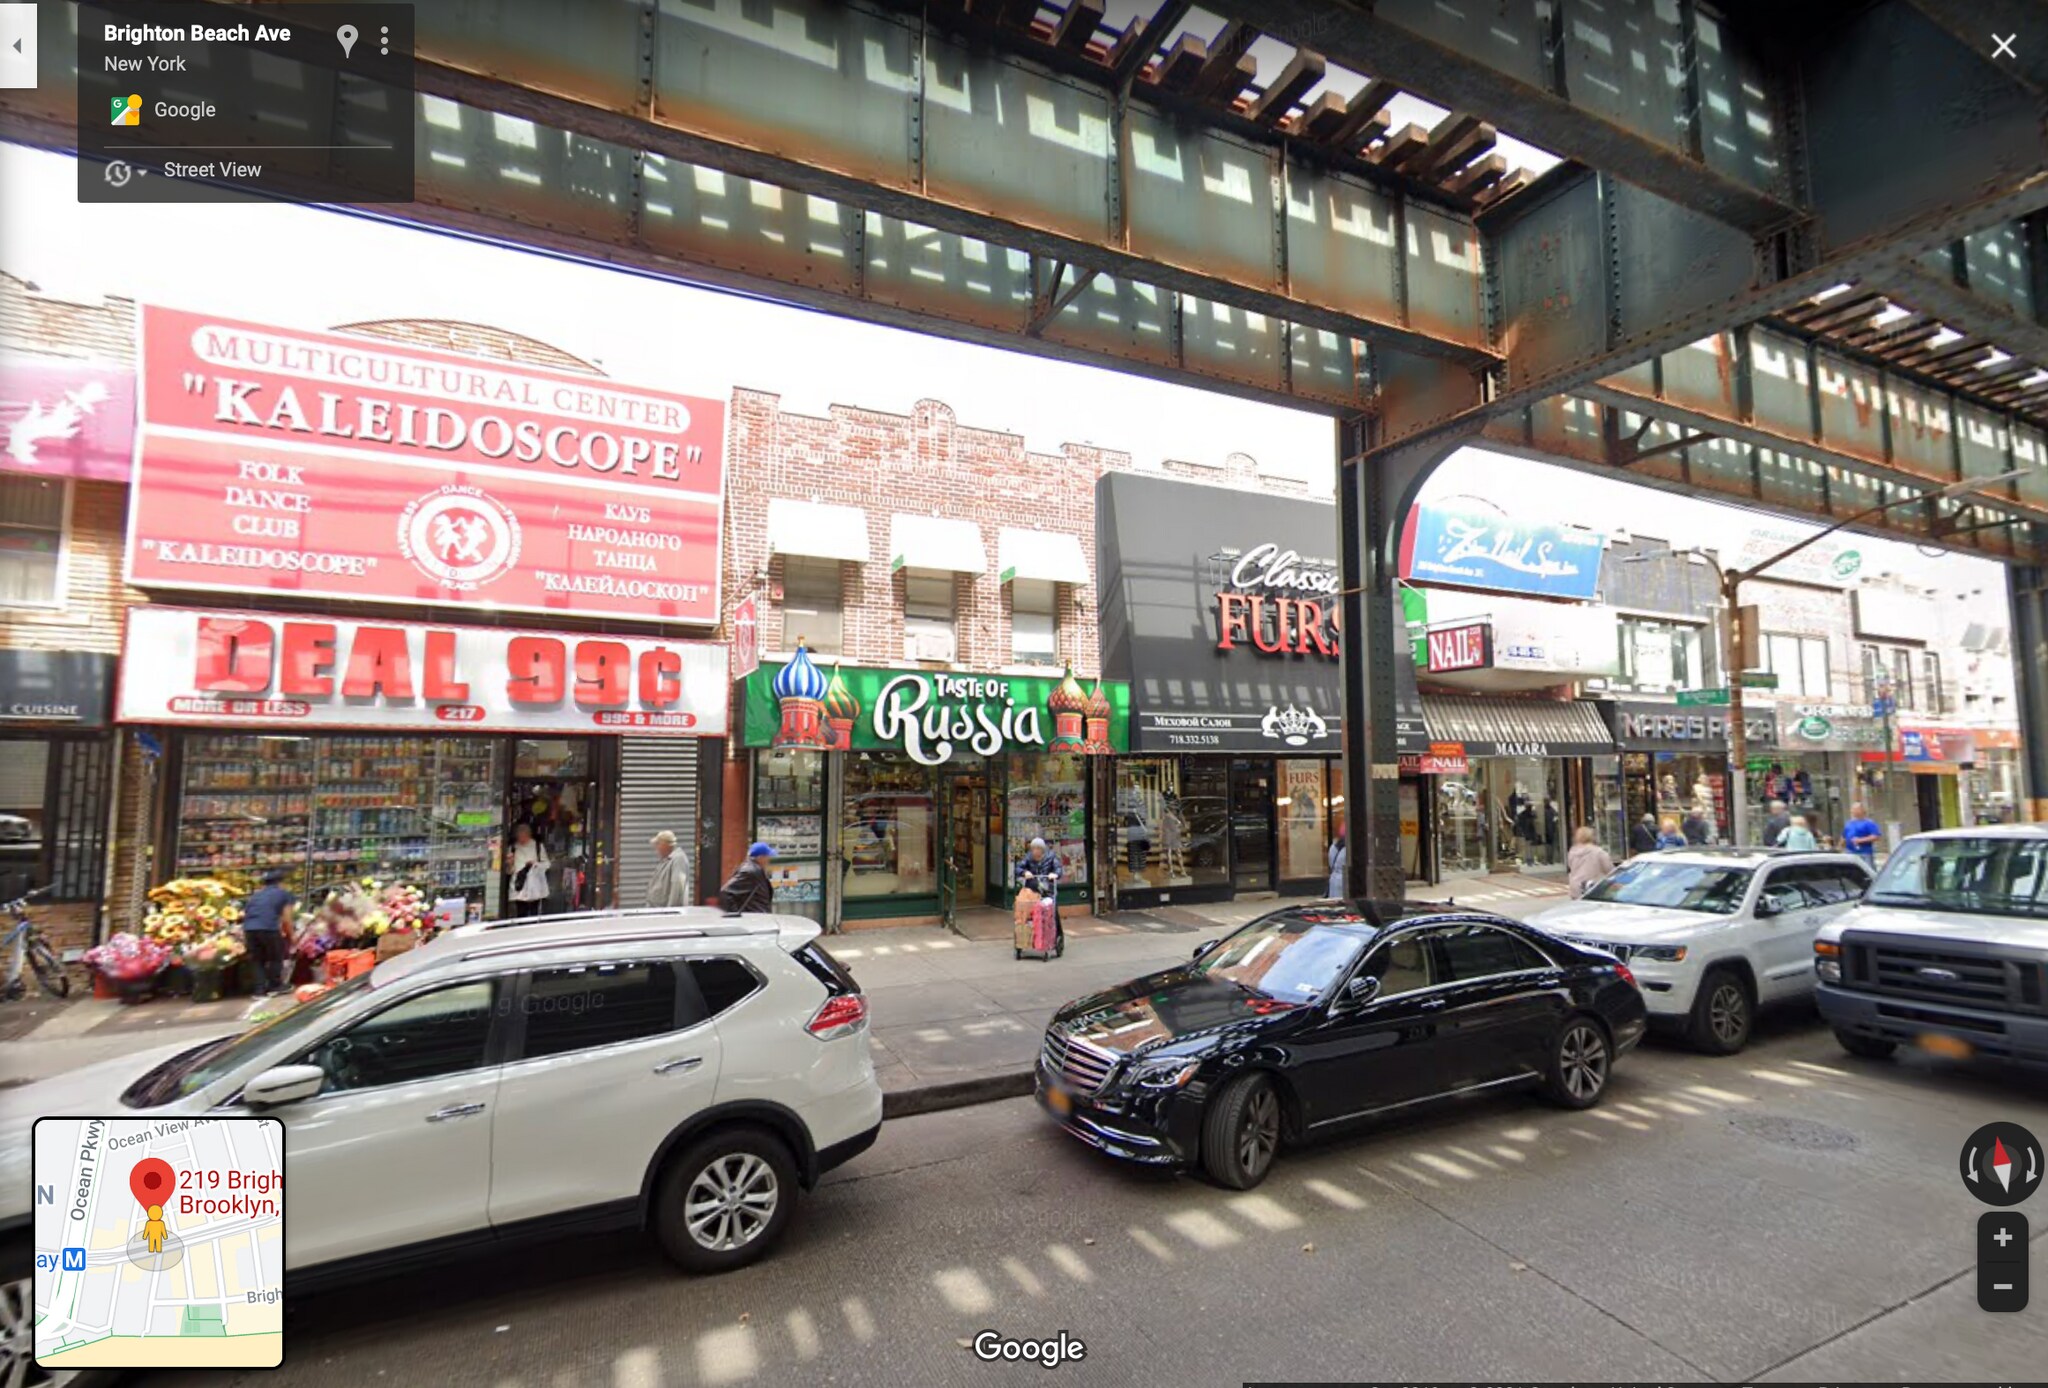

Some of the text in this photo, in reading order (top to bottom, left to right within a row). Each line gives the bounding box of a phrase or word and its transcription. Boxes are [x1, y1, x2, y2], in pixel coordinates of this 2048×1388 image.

[206, 332, 682, 428] MULTICULTURAL CENTER
[182, 372, 702, 481] "KALEIDOSCOPE"
[238, 460, 305, 486] FOLK
[224, 485, 312, 514] DANCE
[604, 502, 651, 524] КЛУБ
[232, 514, 300, 538] CLUB
[567, 523, 682, 551] НАРОДНОГО
[593, 549, 658, 572] ТАНЦА
[1428, 628, 1474, 671] NAIL
[194, 616, 471, 704] DEAL
[506, 634, 683, 708] 99¢
[934, 673, 1009, 698] TASTE OF
[173, 699, 306, 716] MORE OR LESS
[444, 707, 477, 720] 217
[873, 673, 1046, 766] Russia
[649, 714, 690, 727] MORE
[1168, 735, 1220, 745] 718.332.5138
[1495, 742, 1548, 756] MAXARA
[1432, 758, 1466, 769] NAIL
[1289, 770, 1319, 784] FURS
